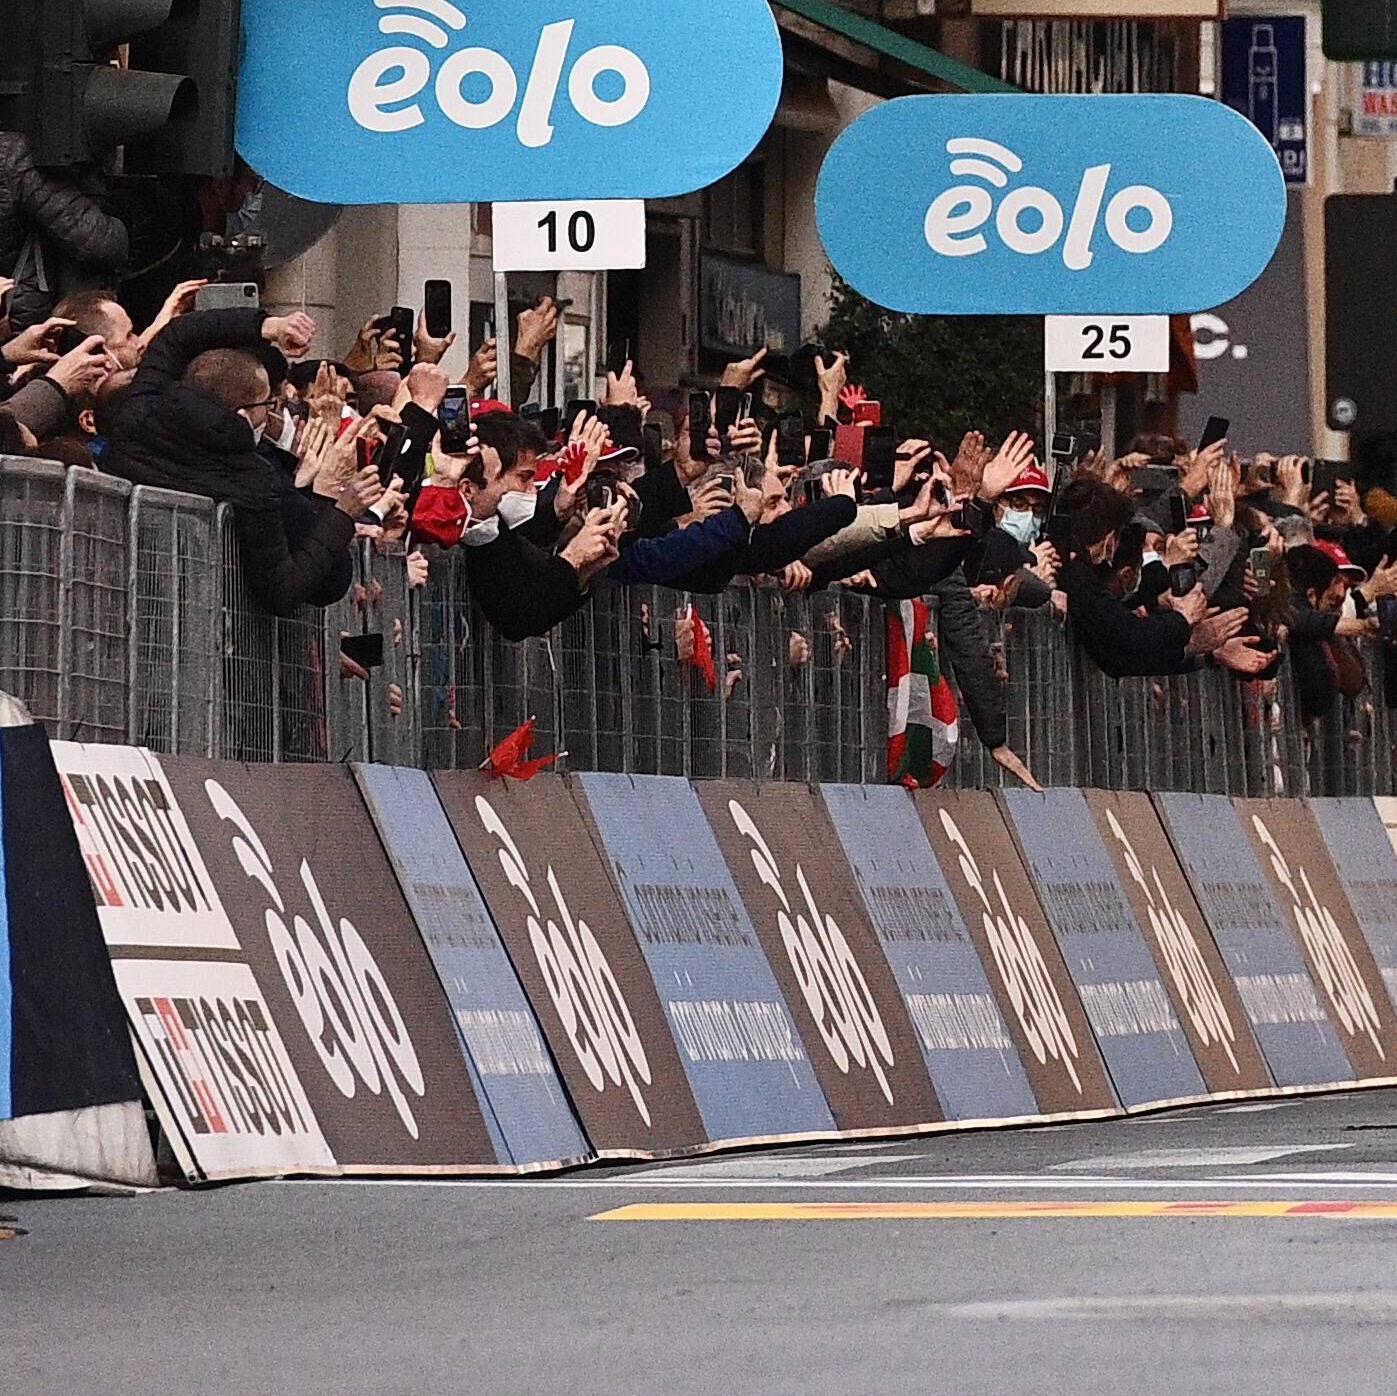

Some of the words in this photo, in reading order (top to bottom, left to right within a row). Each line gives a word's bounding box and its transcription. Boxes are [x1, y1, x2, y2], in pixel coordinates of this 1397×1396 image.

[348, 19, 650, 147] eolo
[537, 210, 595, 253] 10
[924, 164, 1173, 270] eolo
[1081, 324, 1132, 359] 25
